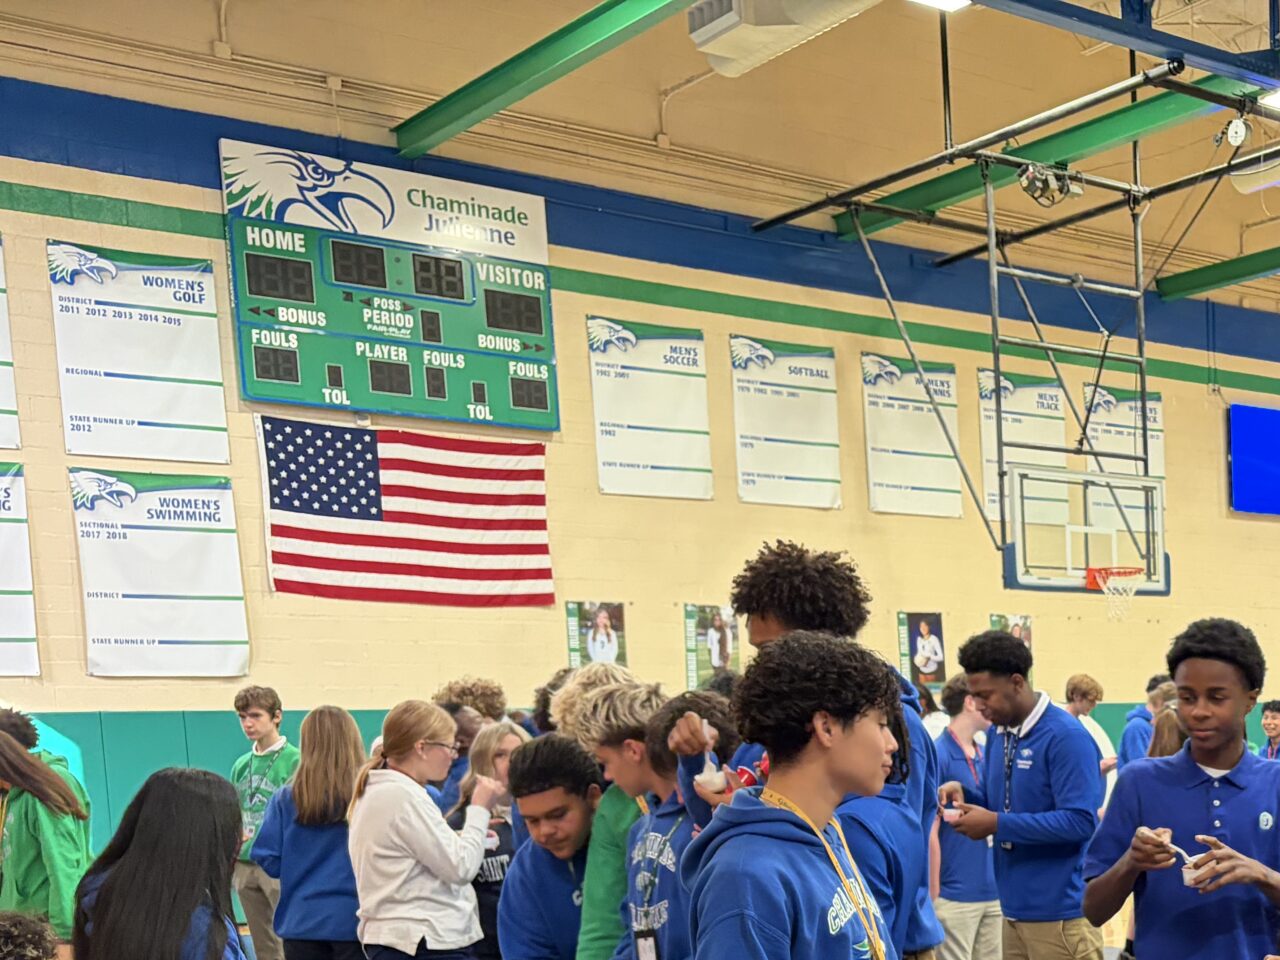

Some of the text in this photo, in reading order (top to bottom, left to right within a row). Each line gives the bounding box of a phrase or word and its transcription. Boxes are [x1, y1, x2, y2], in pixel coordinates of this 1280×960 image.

[406, 189, 529, 226] Chaminade
[425, 214, 516, 247] Julienne
[246, 226, 306, 253] HOME
[142, 275, 205, 293] WOMEN'S
[476, 262, 546, 291] VISITOR
[59, 295, 92, 305] DISTRICT
[172, 290, 206, 305] GOLF
[373, 297, 401, 311] POSS
[59, 304, 181, 326] 2011 2012 2013 2014 2015
[278, 307, 327, 327] BONUS
[363, 309, 415, 328] PERIOD
[251, 329, 299, 348] FOULS
[477, 334, 521, 353] BONUS
[355, 342, 408, 362] PLAYER
[669, 345, 698, 358] MEN'S
[423, 351, 466, 369] FOULS
[663, 354, 699, 368] SOCCER
[65, 367, 102, 378] REGIONAL
[508, 361, 549, 379] FOULS
[788, 365, 830, 380] SOFTBALL
[914, 376, 951, 389] WMEN'S
[322, 388, 350, 406] TOL
[466, 404, 494, 421] TOL
[1035, 401, 1059, 413] TRACK
[70, 415, 136, 427] STATE RUNNER UP
[70, 423, 92, 433] 2012
[158, 497, 221, 511] WOMEN'S
[146, 508, 222, 523] SWIMMING
[80, 521, 119, 530] SECTIONAL
[80, 530, 101, 540] 2017
[87, 591, 119, 600] DISTRICT
[92, 637, 111, 647] STATE
